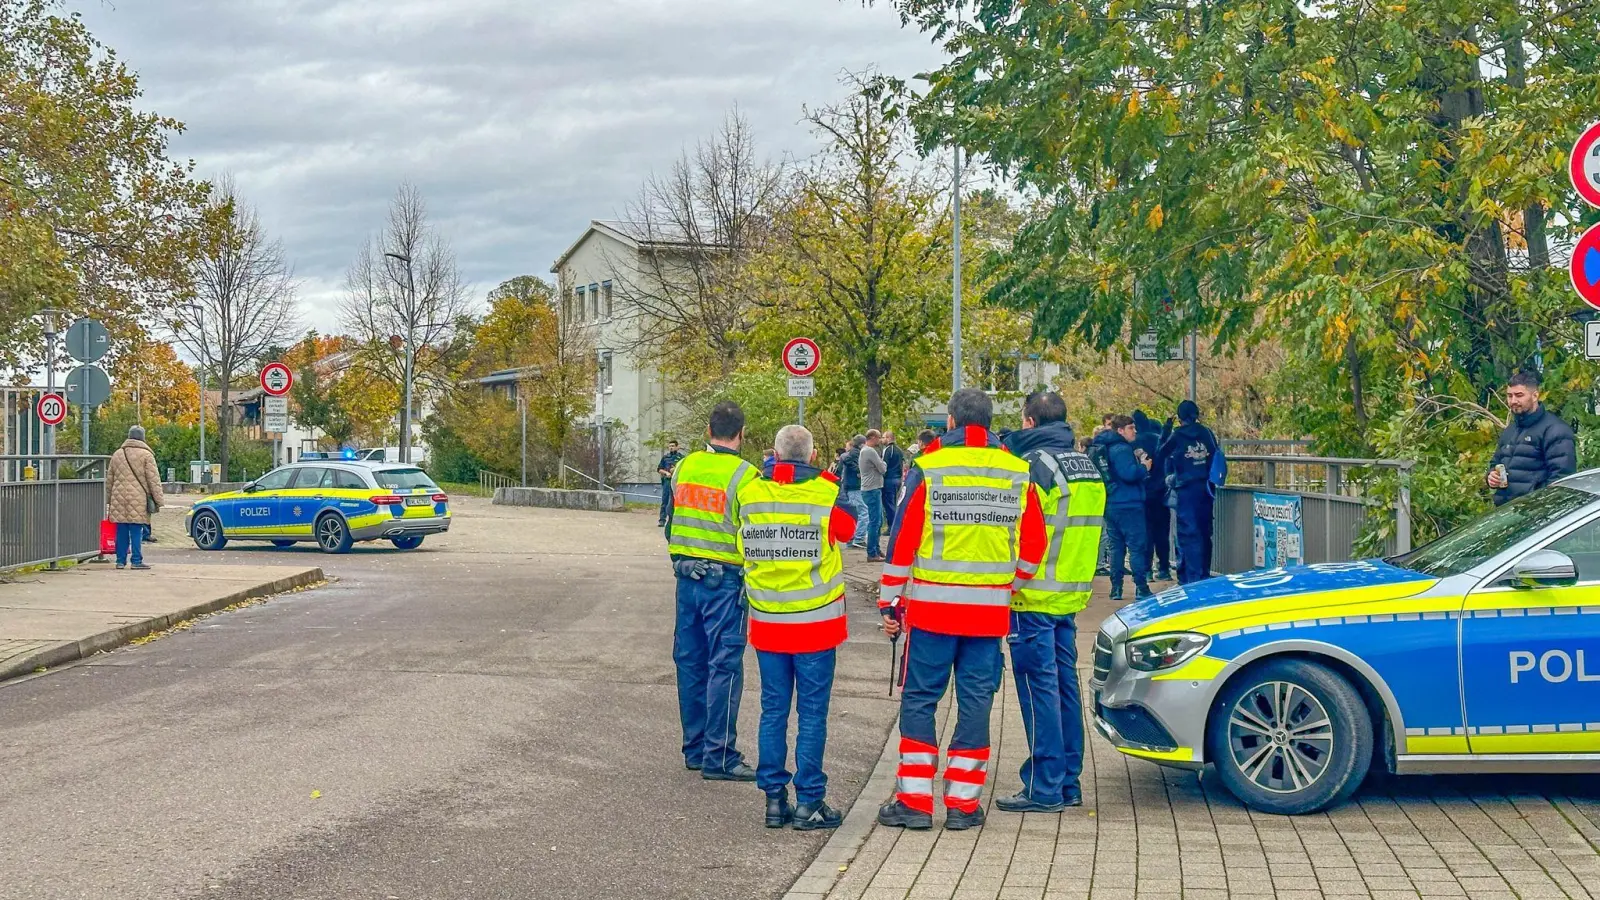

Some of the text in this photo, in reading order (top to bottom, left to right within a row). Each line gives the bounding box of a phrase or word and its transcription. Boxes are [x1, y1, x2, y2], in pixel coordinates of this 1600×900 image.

[44, 402, 60, 416] 20
[932, 490, 1019, 504] Organisatorischer Leiter
[240, 507, 271, 517] POLIZEI
[933, 510, 1018, 524] Rettungsdienst
[742, 526, 819, 541] Leitender Notarzt
[744, 546, 819, 560] Rettungsdienst
